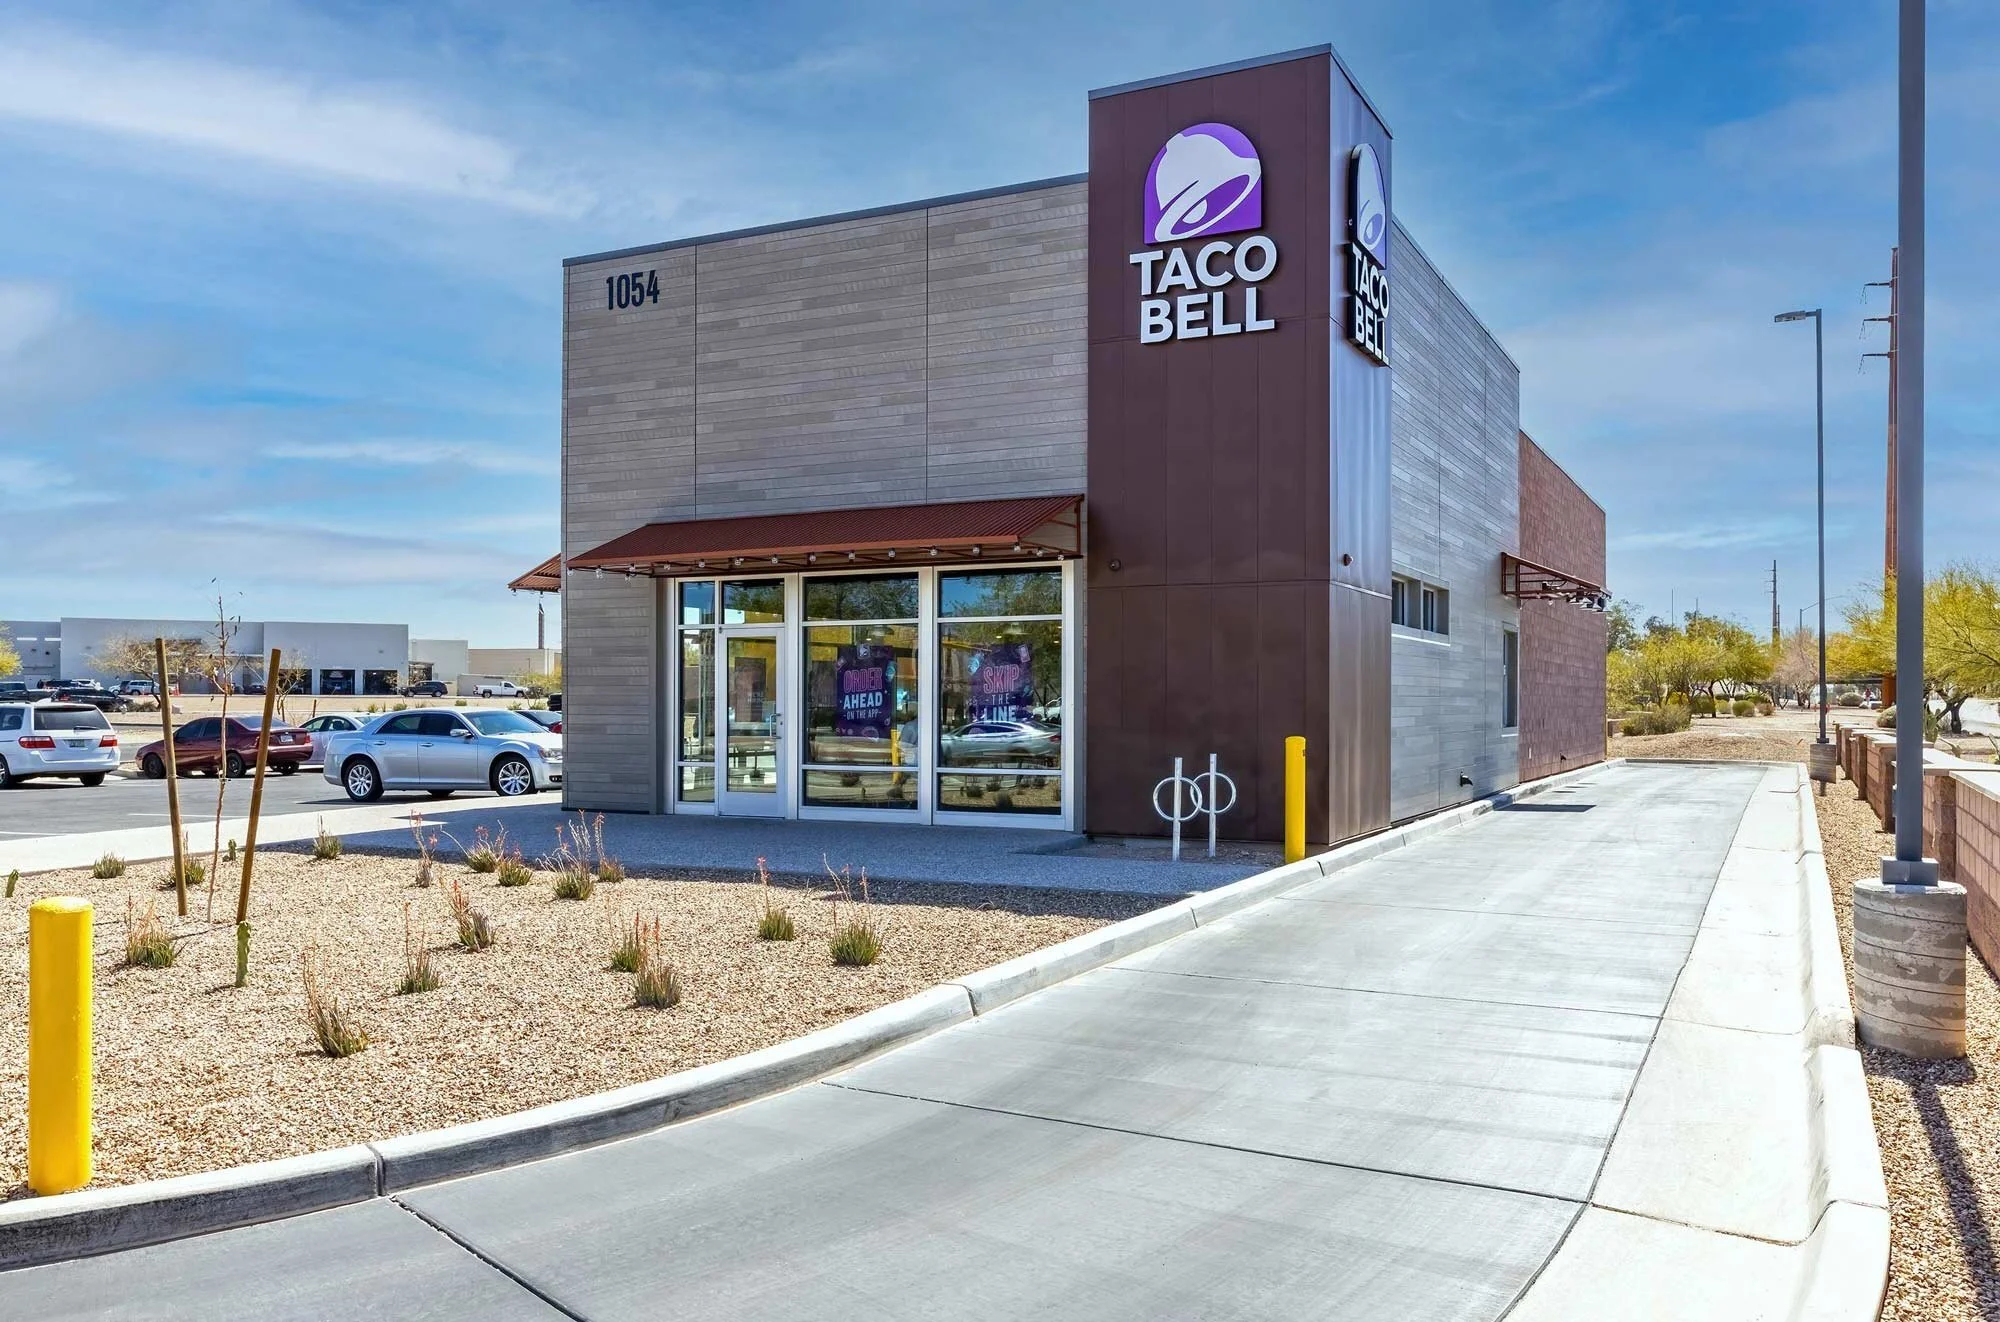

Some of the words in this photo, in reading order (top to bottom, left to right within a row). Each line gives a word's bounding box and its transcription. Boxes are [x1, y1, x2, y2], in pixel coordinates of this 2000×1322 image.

[1129, 235, 1277, 296] TACO
[1352, 242, 1390, 318] TACO
[606, 270, 660, 310] 1054
[1140, 286, 1275, 344] BELL
[1355, 295, 1390, 365] BELL
[843, 667, 883, 694] ORDER
[983, 663, 1020, 694] SKIP
[843, 691, 883, 710] AHEAD
[857, 709, 866, 719] THE
[983, 705, 1017, 724] LINE
[992, 693, 1010, 706] THE
